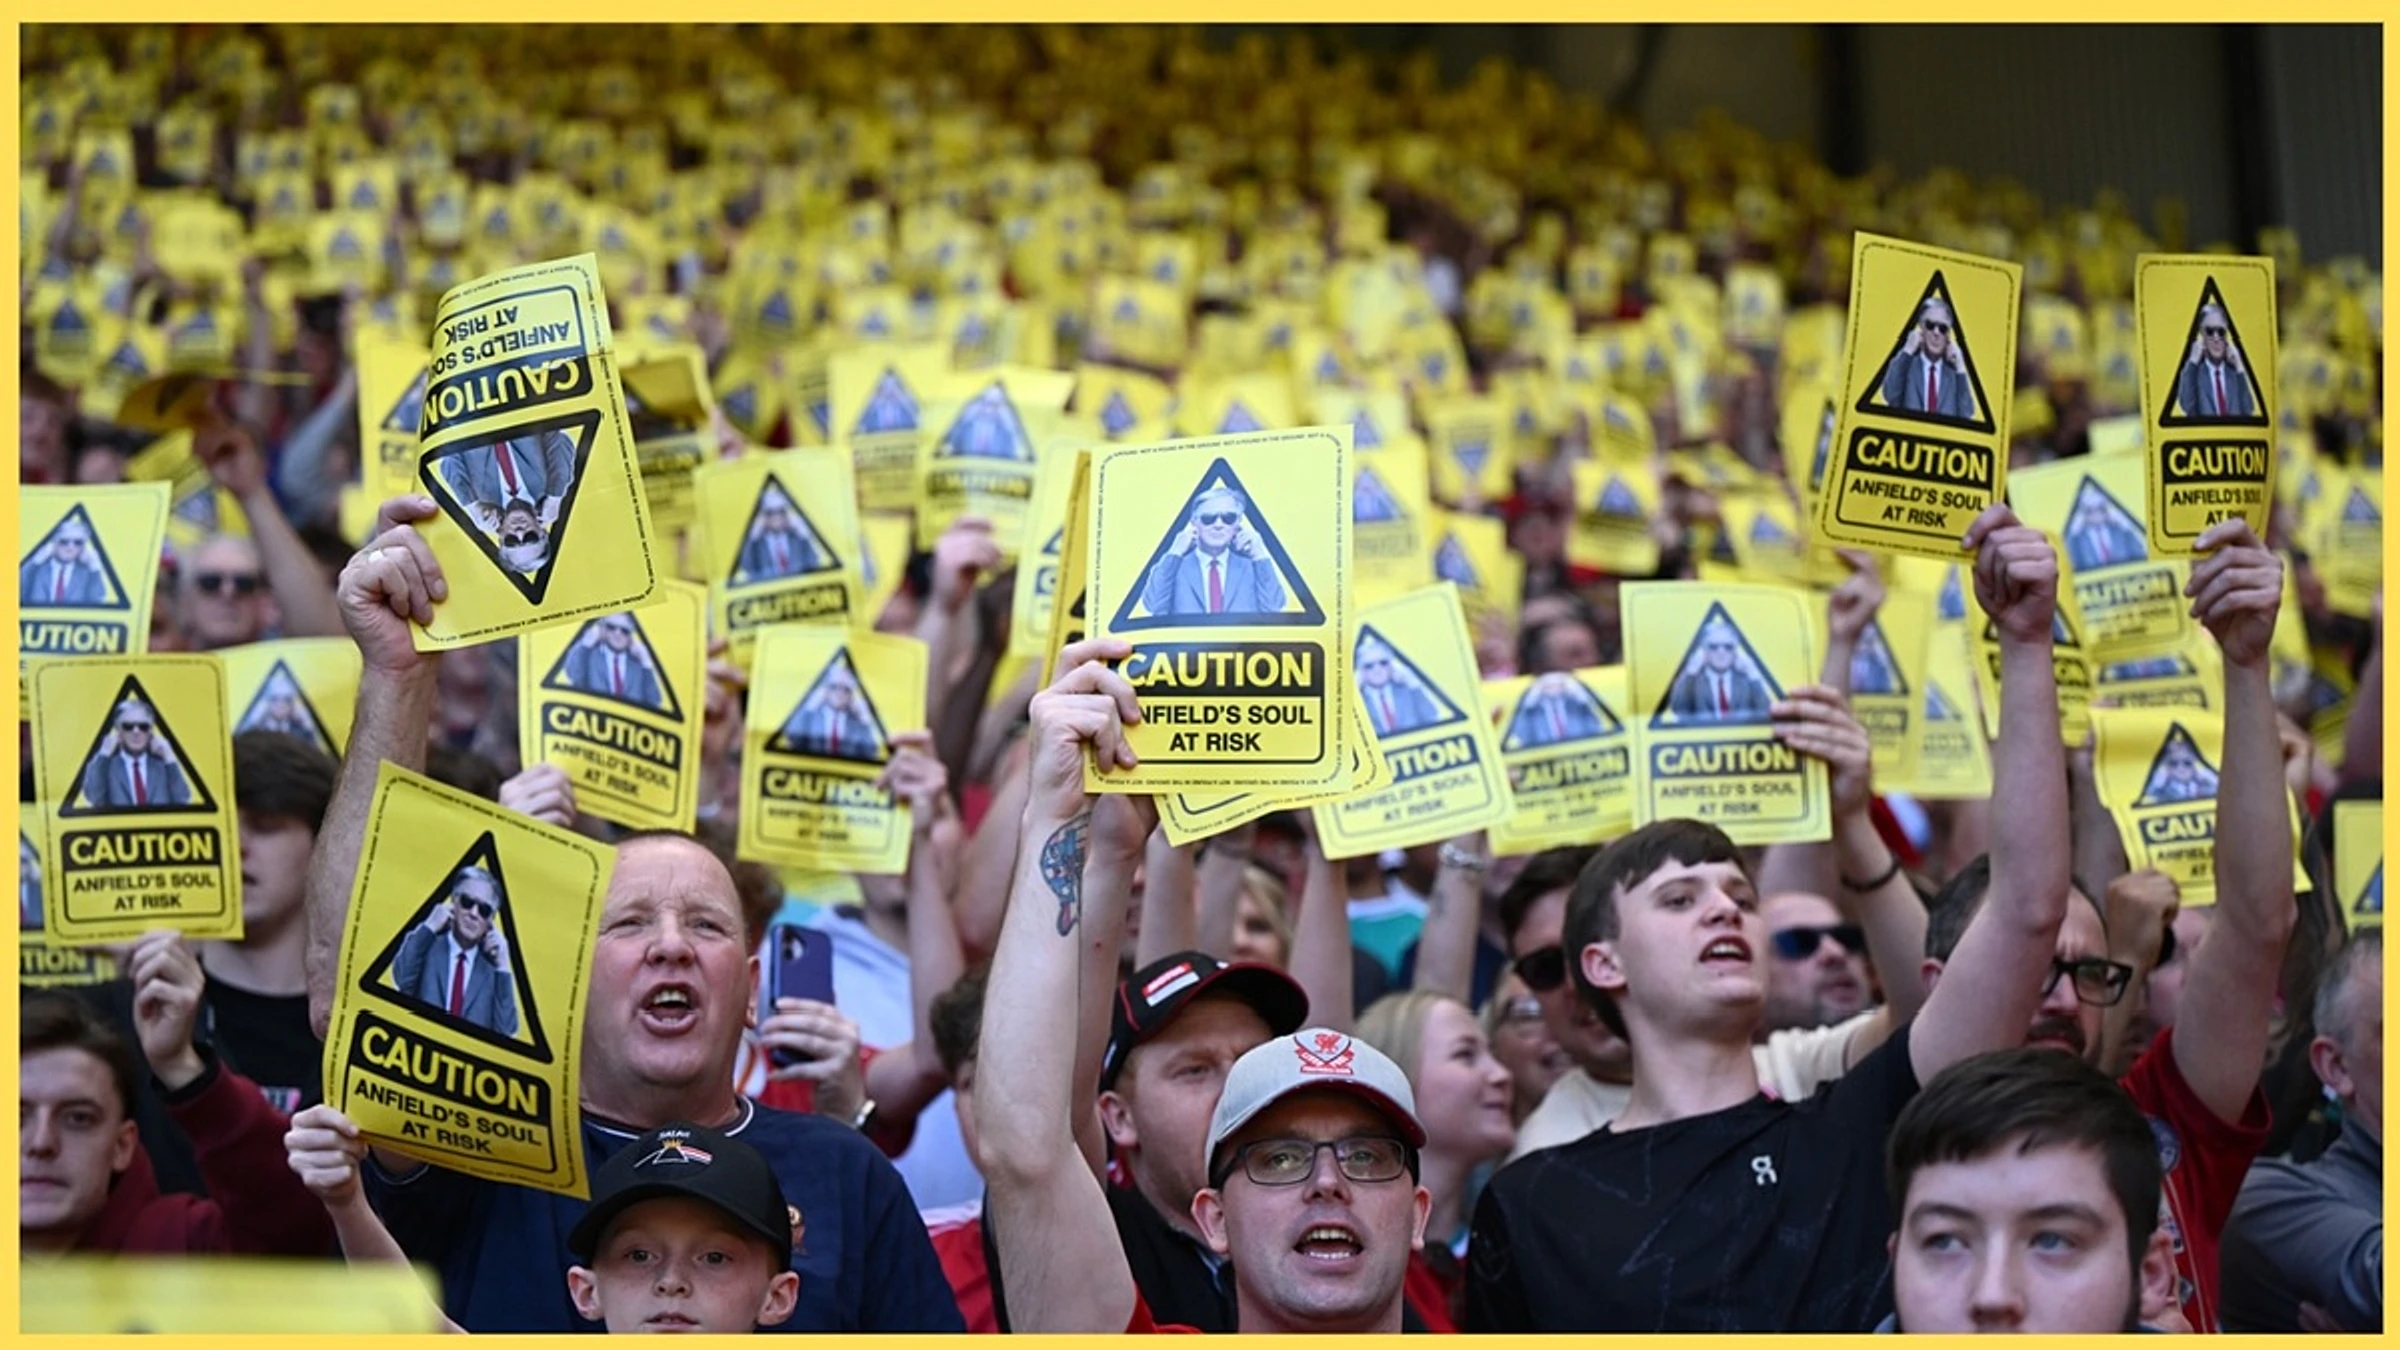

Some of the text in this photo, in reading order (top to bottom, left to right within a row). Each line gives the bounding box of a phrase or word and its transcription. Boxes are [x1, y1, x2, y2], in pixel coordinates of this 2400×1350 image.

[444, 306, 519, 346] AT RISK
[431, 321, 571, 378] ANFIELD'S SO
[422, 358, 581, 432] CAUTION
[1856, 435, 1987, 482] CAUTION
[2168, 446, 2265, 477] CAUTION
[1850, 478, 1985, 512] ANFIELD'S SOUL
[2171, 489, 2241, 506] ANFIELD'S
[1882, 505, 1948, 529] AT RISK
[19, 623, 120, 652] UTION
[1118, 652, 1312, 687] CAUTION
[1140, 705, 1312, 724] NFIELD'S SOUL
[549, 706, 676, 763] CAUTION
[1169, 732, 1262, 751] AT RISK
[1657, 743, 1796, 774] CAUTION
[70, 832, 214, 865] CAUTION
[73, 871, 216, 893] ANFIELD'S SOUL
[114, 893, 182, 911] AT RISK
[21, 950, 88, 973] TION
[361, 1026, 538, 1116] CAUTION
[355, 1078, 542, 1147] ANFIELD'S SOUL
[402, 1120, 492, 1154] AT RISK
